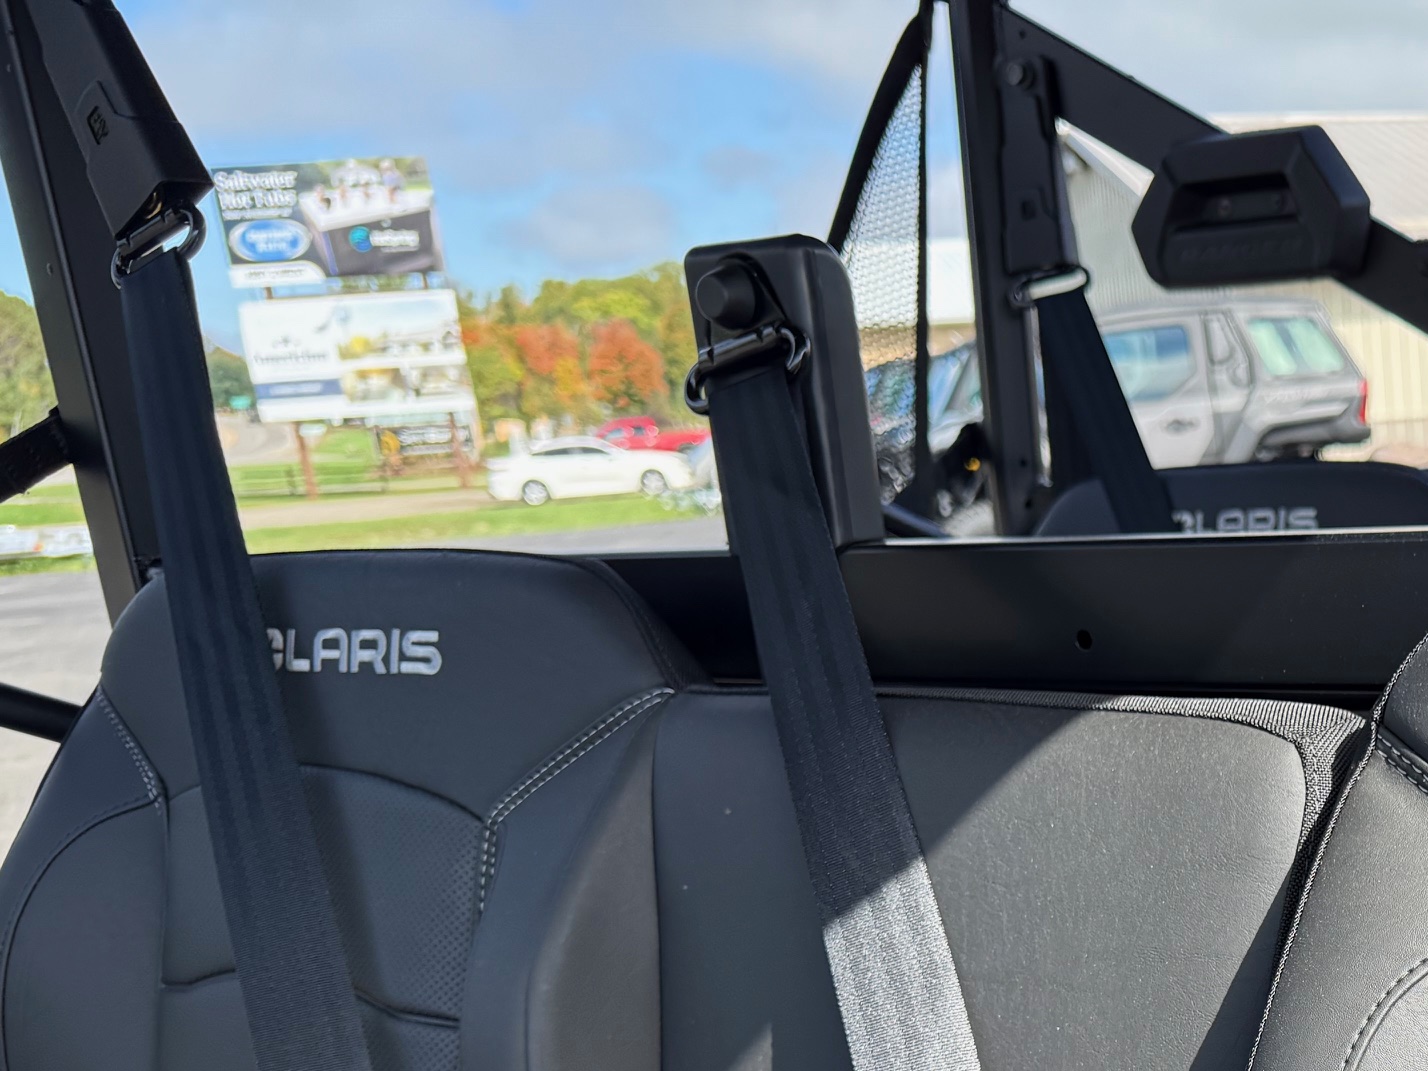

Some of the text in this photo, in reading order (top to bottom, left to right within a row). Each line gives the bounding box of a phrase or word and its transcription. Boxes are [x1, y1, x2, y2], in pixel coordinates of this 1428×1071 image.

[214, 170, 297, 191] Saltwater
[219, 189, 296, 210] Hot Tubs
[267, 628, 442, 675] LARIS
